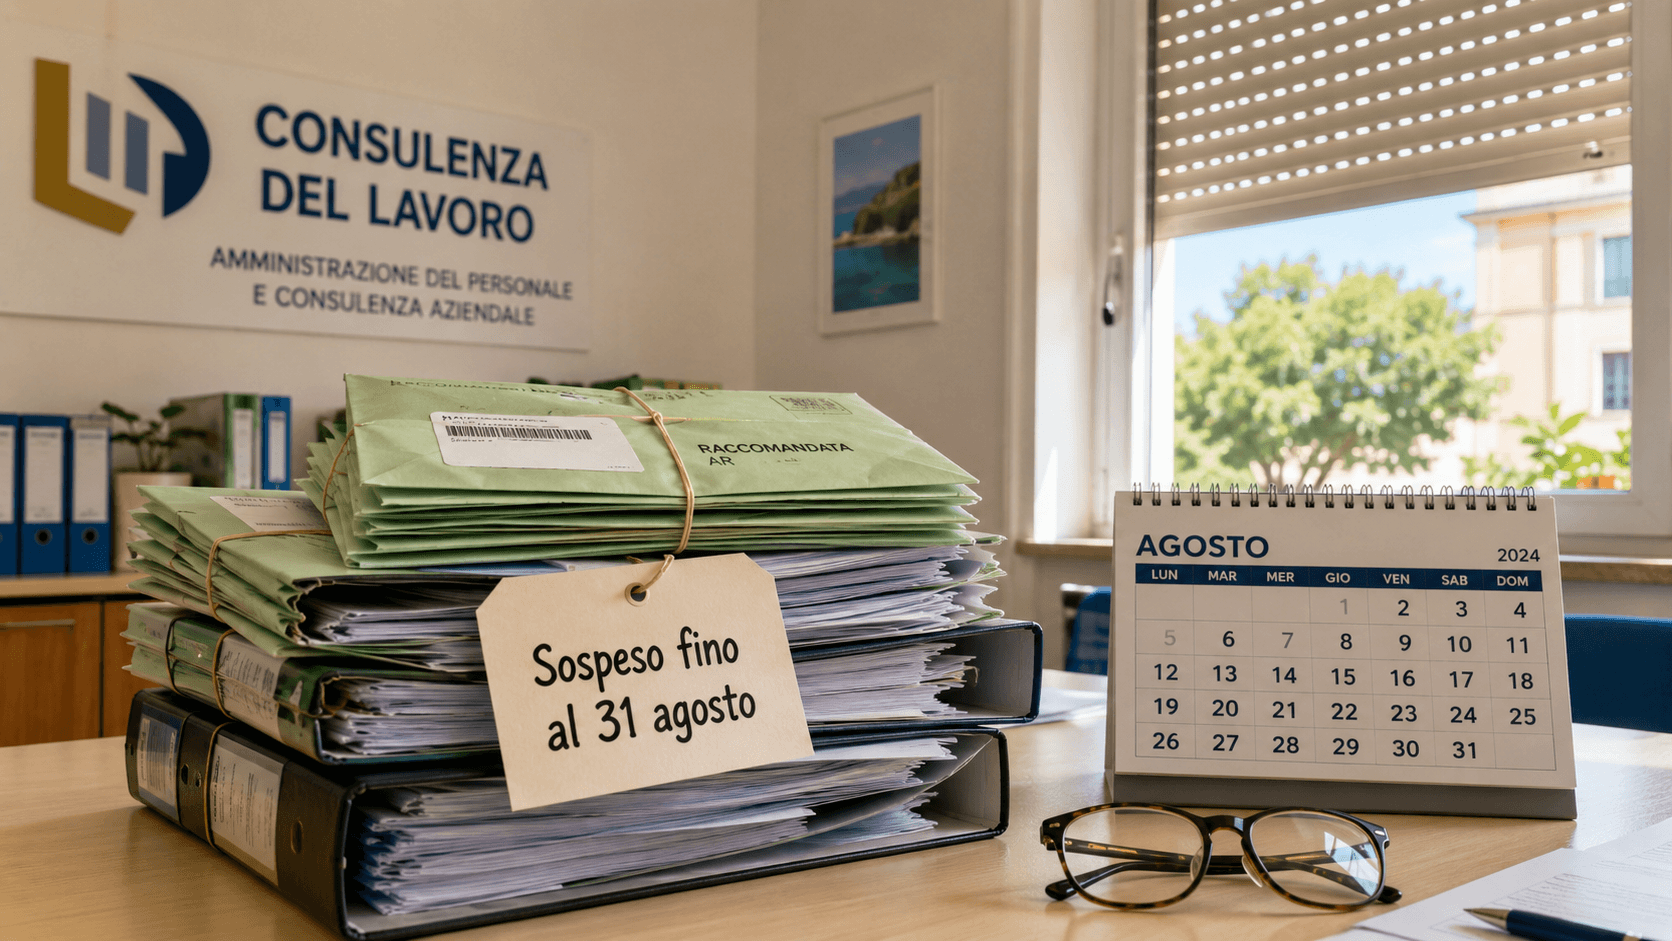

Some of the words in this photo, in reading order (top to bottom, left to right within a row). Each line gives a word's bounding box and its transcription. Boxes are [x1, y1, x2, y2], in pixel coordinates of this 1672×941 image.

[255, 103, 549, 191] CONSULENZA
[261, 168, 350, 222] DEL
[369, 181, 534, 244] LAVORO
[209, 246, 418, 287] AMMINISTRAZIONE
[425, 267, 462, 291] DEL
[467, 271, 572, 301] PERSONALE
[253, 283, 266, 306] E
[274, 285, 423, 317] CONSULENZA
[429, 299, 535, 327] AZIENDALE
[697, 442, 854, 454] RACCOMANDATA
[709, 455, 735, 466] AR
[1135, 534, 1269, 559] AGOSTO
[1497, 548, 1541, 563] 2024
[1151, 569, 1178, 580] LUN
[1208, 570, 1237, 582] MAR
[1266, 571, 1295, 583] MER
[1325, 572, 1351, 584] GIO
[1382, 573, 1410, 585] VEN
[1441, 574, 1469, 586] SAB
[1496, 575, 1529, 587] DOM
[1339, 598, 1348, 615] 1
[1397, 599, 1410, 617] 2
[1455, 600, 1468, 618] 3
[1513, 601, 1527, 619] 4
[1163, 629, 1177, 646] 5
[1222, 630, 1235, 648] 6
[1281, 631, 1294, 649] 7
[1340, 632, 1353, 651] 8
[1398, 634, 1412, 652] 9
[1447, 635, 1472, 653] 10
[1506, 636, 1528, 654] 11
[532, 643, 664, 693] Sospeso
[676, 625, 739, 670] fino
[1154, 663, 1179, 681] 12
[1212, 664, 1238, 683] 13
[1272, 666, 1297, 684] 14
[1331, 667, 1356, 686] 15
[1390, 669, 1416, 687] 16
[1449, 670, 1474, 689] 17
[1508, 672, 1534, 690] 18
[547, 703, 581, 752] al
[594, 696, 637, 743] 31
[653, 684, 756, 744] agosto
[1153, 697, 1179, 715] 19
[1212, 699, 1239, 717] 20
[1272, 700, 1295, 719] 21
[1331, 702, 1358, 721] 22
[1390, 704, 1418, 723] 23
[1450, 706, 1478, 724] 24
[1509, 707, 1537, 726] 25
[1152, 731, 1180, 750] 26
[1212, 733, 1239, 752] 27
[1272, 735, 1300, 754] 28
[1332, 737, 1360, 756] 29
[1392, 739, 1420, 758] 30
[1452, 741, 1476, 759] 31
